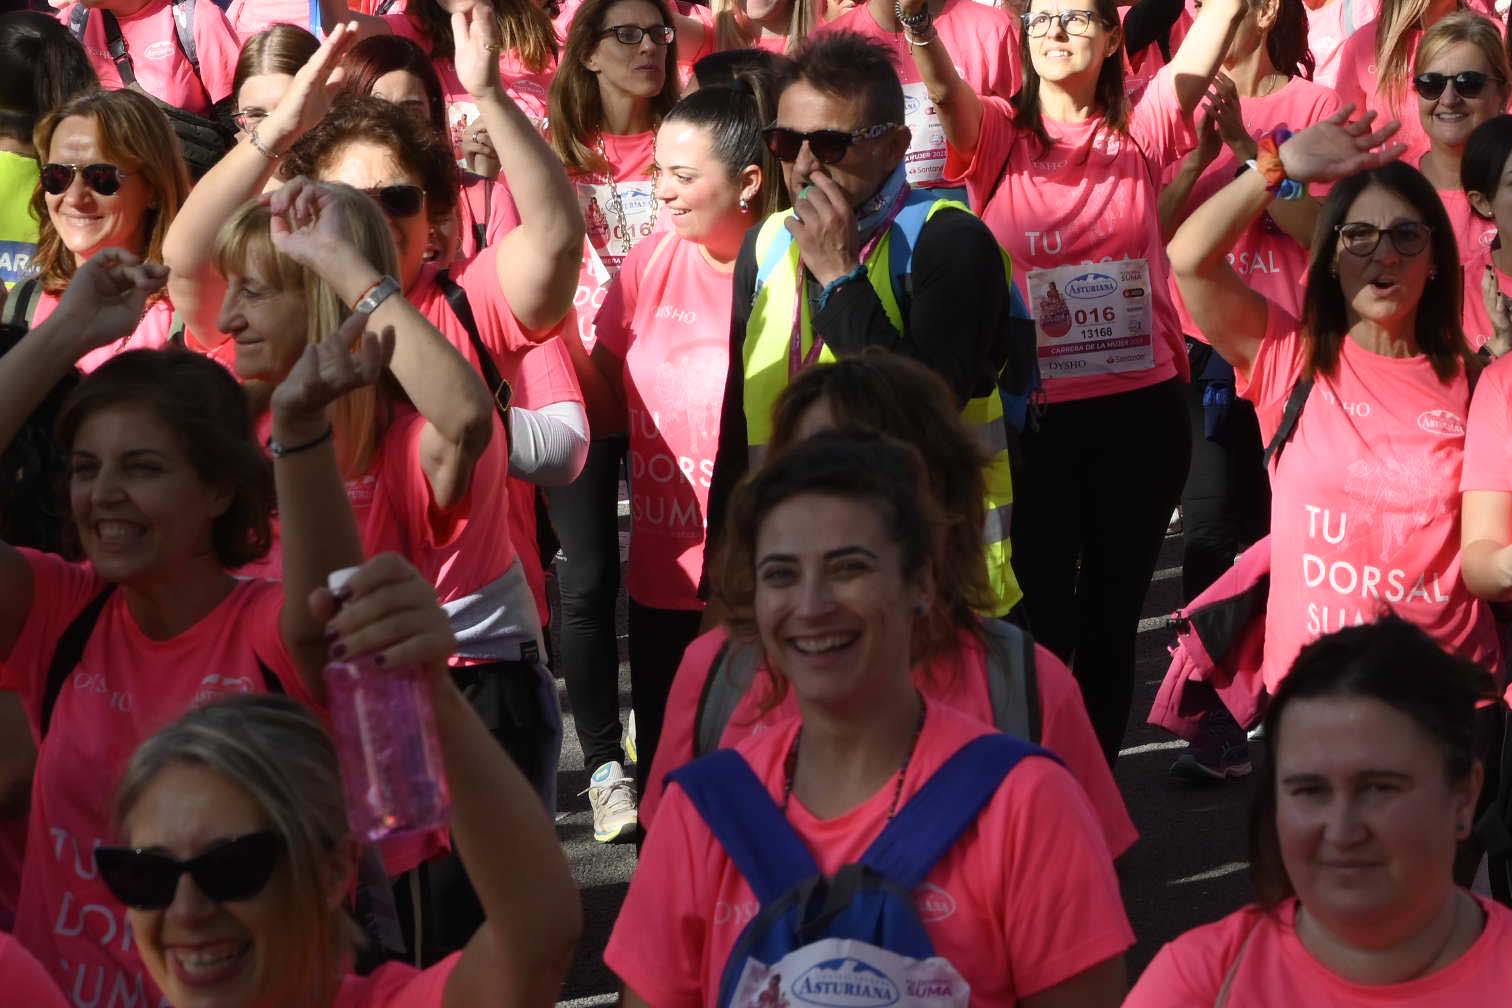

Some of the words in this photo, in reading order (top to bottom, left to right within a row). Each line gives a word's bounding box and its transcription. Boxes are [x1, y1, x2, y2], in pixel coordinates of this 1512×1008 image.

[1025, 231, 1063, 257] TU
[1070, 283, 1113, 294] ASTURIANA
[1075, 307, 1116, 324] 016
[1081, 328, 1112, 339] 13168
[1051, 345, 1083, 354] CARRERA
[629, 409, 660, 439] TU
[632, 496, 706, 528] SUM
[1305, 505, 1347, 543] TU
[1303, 554, 1449, 603] DORSAL
[800, 976, 892, 1001] ASTURIANA
[907, 980, 952, 999] SUMA
